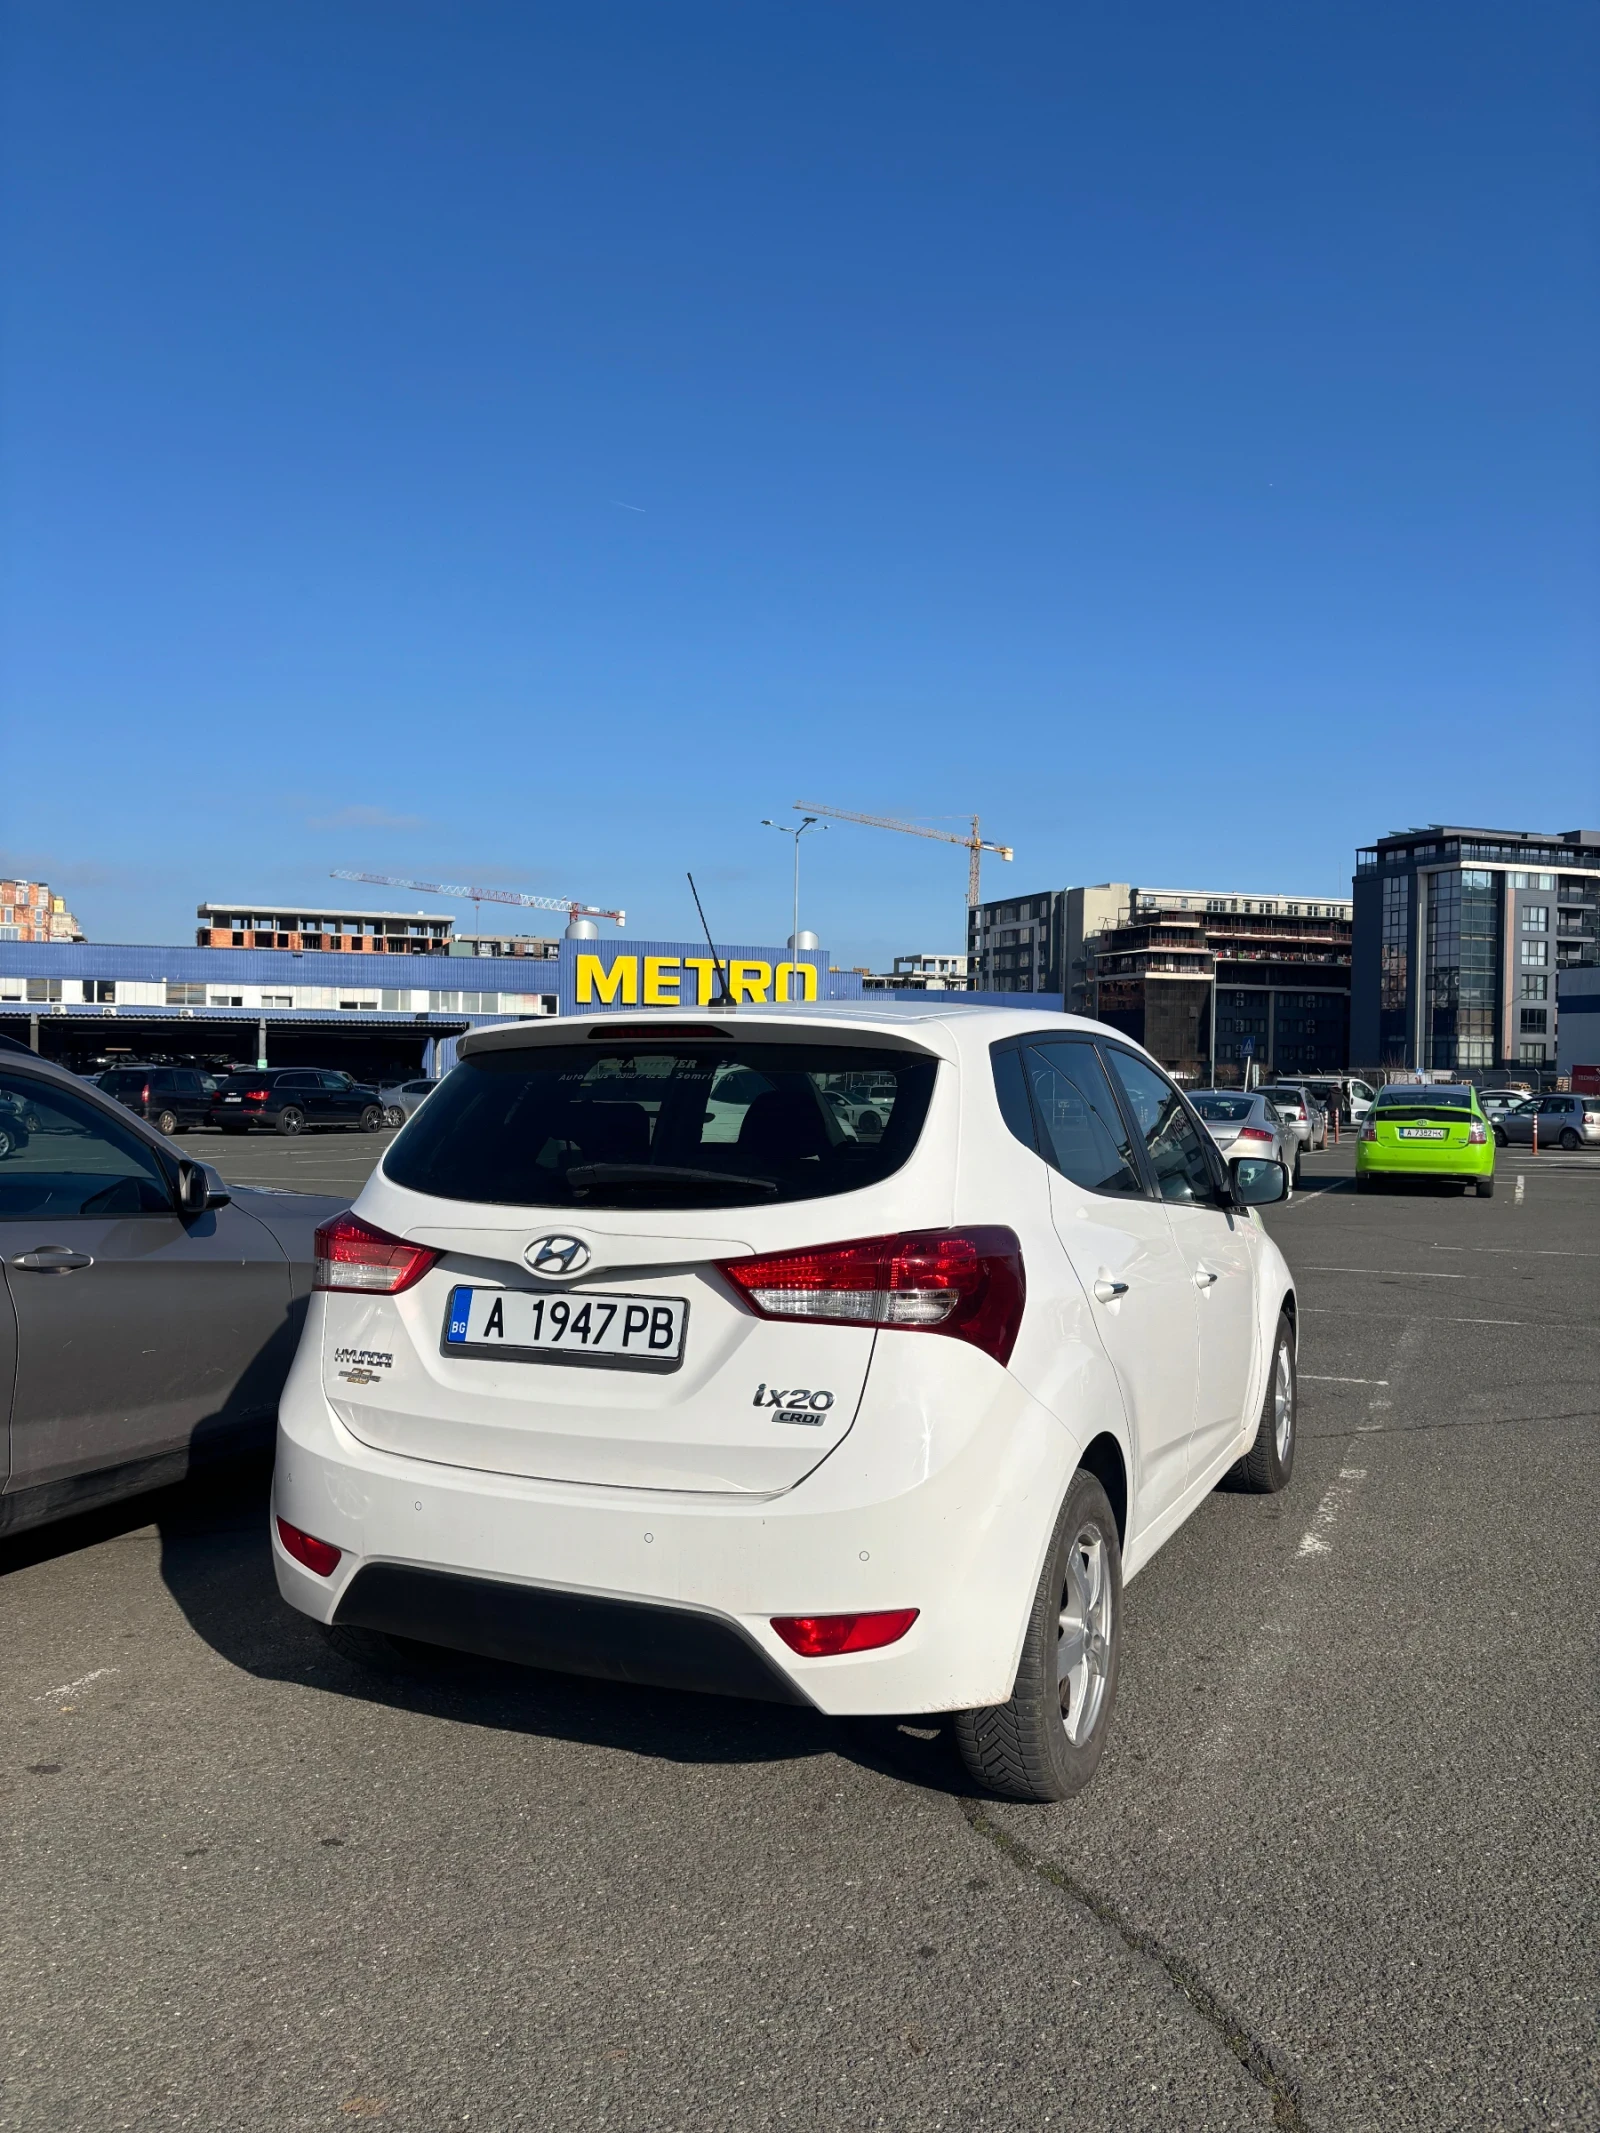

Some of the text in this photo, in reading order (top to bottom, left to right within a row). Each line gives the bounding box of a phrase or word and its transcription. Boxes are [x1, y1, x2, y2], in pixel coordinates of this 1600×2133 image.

[576, 954, 817, 1005] METRO
[451, 1321, 466, 1333] BG
[483, 1297, 504, 1338] A
[334, 1348, 393, 1368] HYUNDAI
[753, 1383, 835, 1411] ix20
